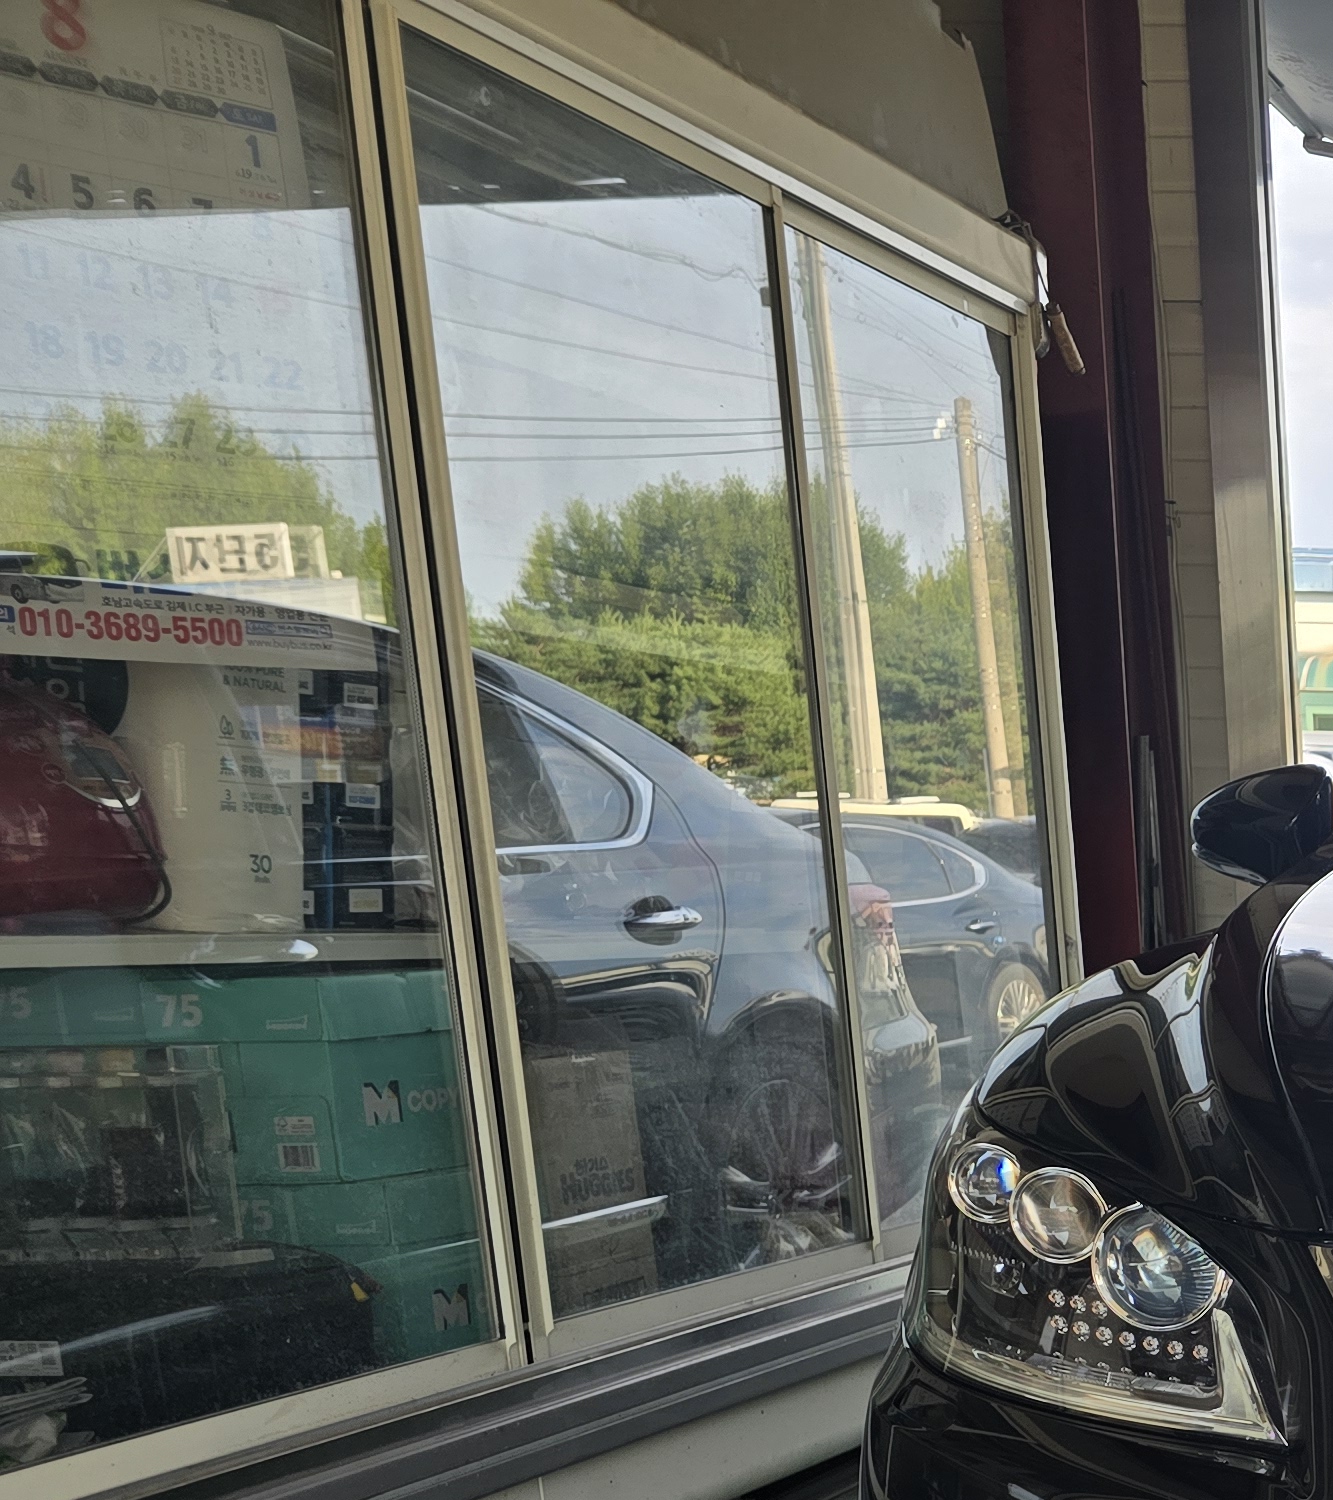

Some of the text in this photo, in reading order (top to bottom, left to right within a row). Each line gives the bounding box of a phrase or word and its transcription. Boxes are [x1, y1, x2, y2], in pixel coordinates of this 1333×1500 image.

[41, 0, 88, 50] 8
[244, 134, 262, 169] 1
[11, 163, 36, 200] 4
[70, 173, 95, 210] 5
[18, 606, 243, 647] 010-3689-5500
[234, 676, 287, 694] NATURAL
[250, 853, 273, 875] 30
[156, 993, 204, 1028] 75
[559, 1166, 635, 1206] HUGGIES
